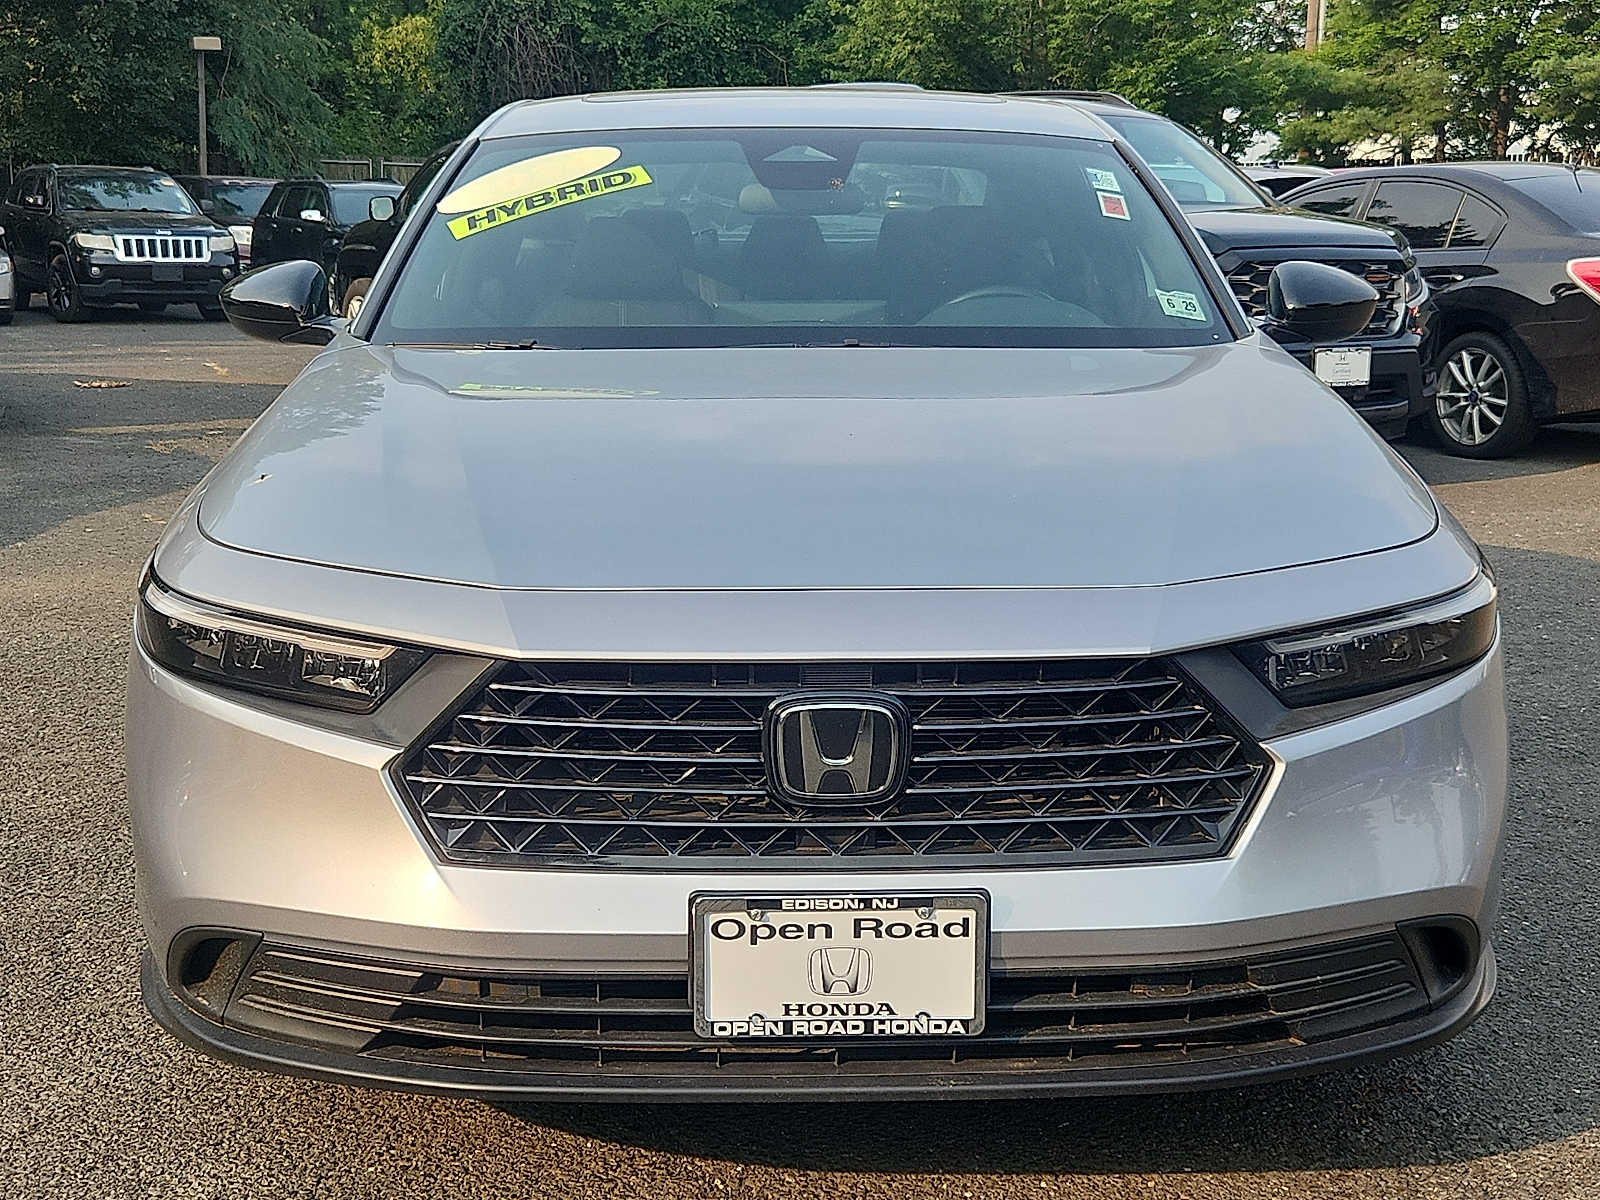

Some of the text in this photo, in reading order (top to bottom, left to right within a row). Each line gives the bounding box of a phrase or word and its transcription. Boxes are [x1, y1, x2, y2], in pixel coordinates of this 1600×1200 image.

[467, 171, 637, 231] HYBRID
[1167, 298, 1197, 312] 6 29
[782, 898, 899, 910] EDISON, NJ
[711, 917, 970, 946] Open Road
[782, 1002, 899, 1017] HONDA
[713, 1020, 966, 1036] OPEN ROAD HONDA
